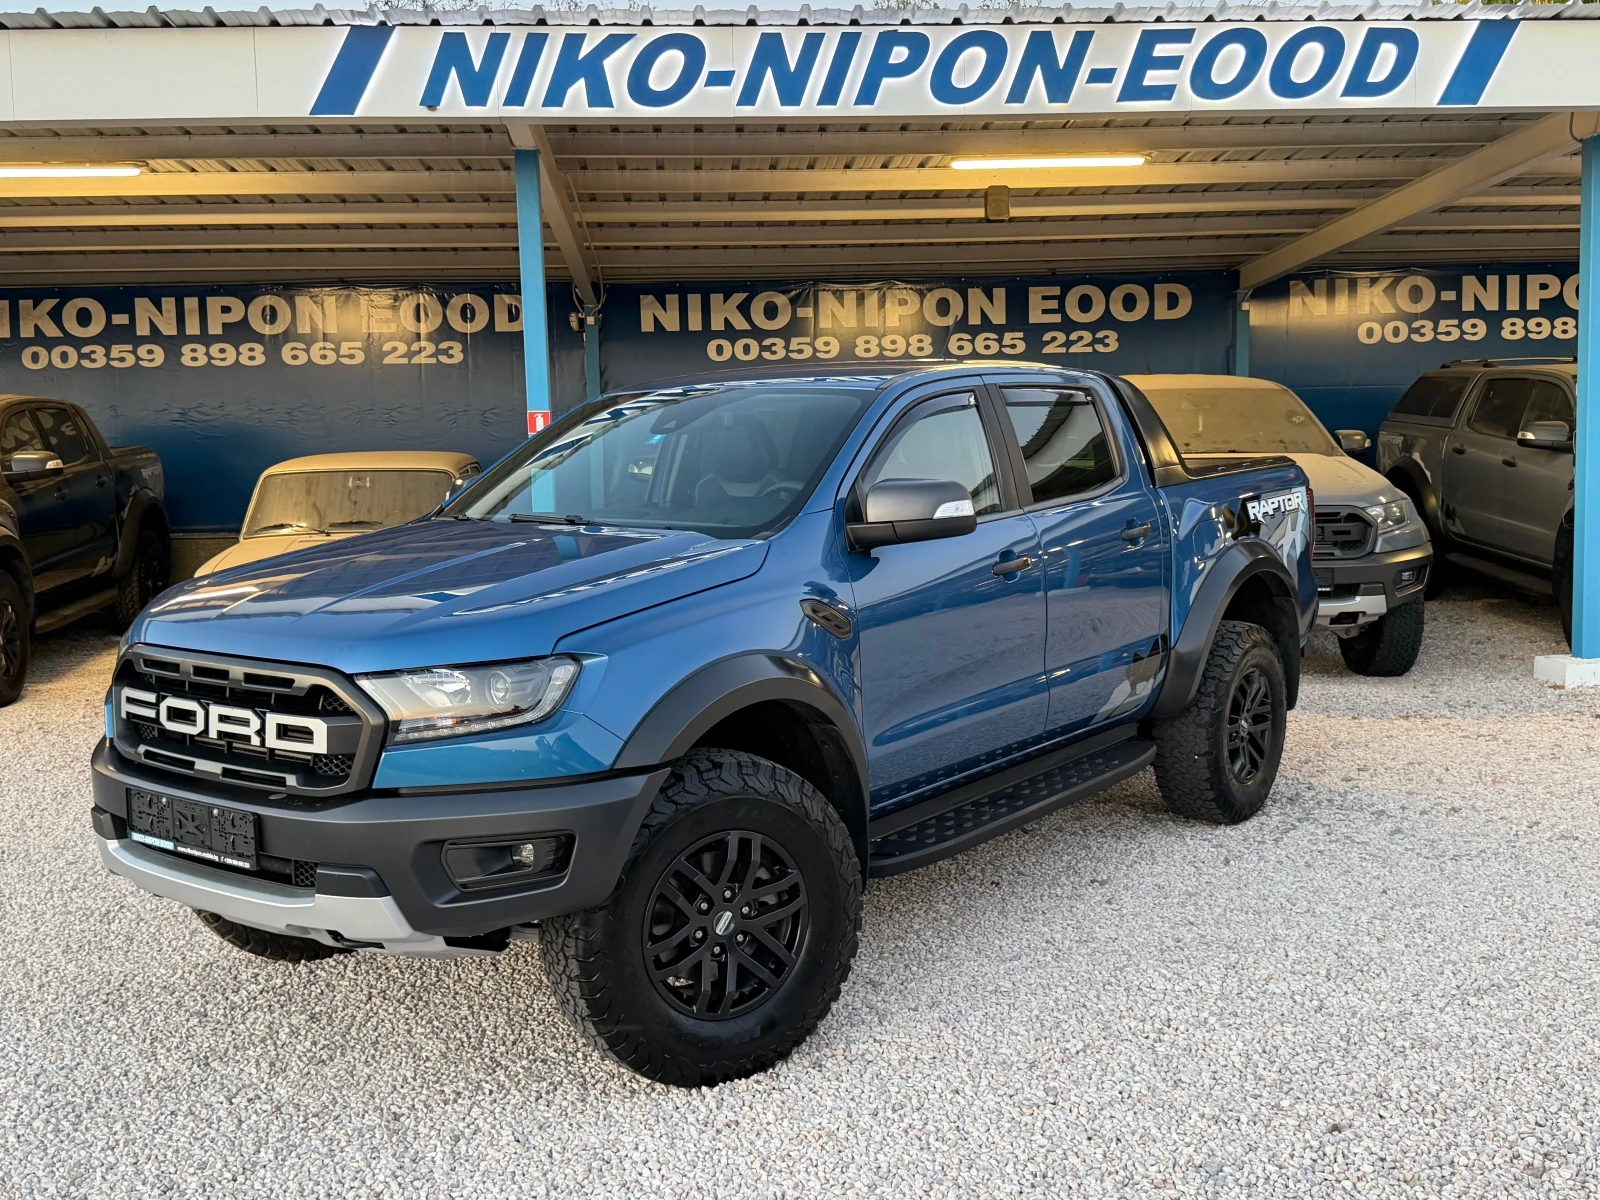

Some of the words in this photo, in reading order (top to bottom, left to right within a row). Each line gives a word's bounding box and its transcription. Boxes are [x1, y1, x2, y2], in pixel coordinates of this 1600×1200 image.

[419, 26, 1420, 108] NIKO-NIPON-EOOD
[361, 293, 523, 333] EOOD
[639, 287, 1006, 332] NIKO-NIPON
[1028, 283, 1192, 324] EOOD
[706, 336, 840, 362] 00359
[854, 334, 933, 358] 898
[948, 331, 1026, 356] 665
[1041, 330, 1119, 354] 223
[1357, 318, 1487, 344] 00359
[1501, 316, 1577, 341] 898
[21, 344, 165, 370] 00359
[180, 342, 265, 367] 898
[280, 341, 366, 366] 665
[381, 340, 464, 365] 223
[1246, 491, 1304, 526] RAPTOR
[121, 686, 327, 754] FORD
